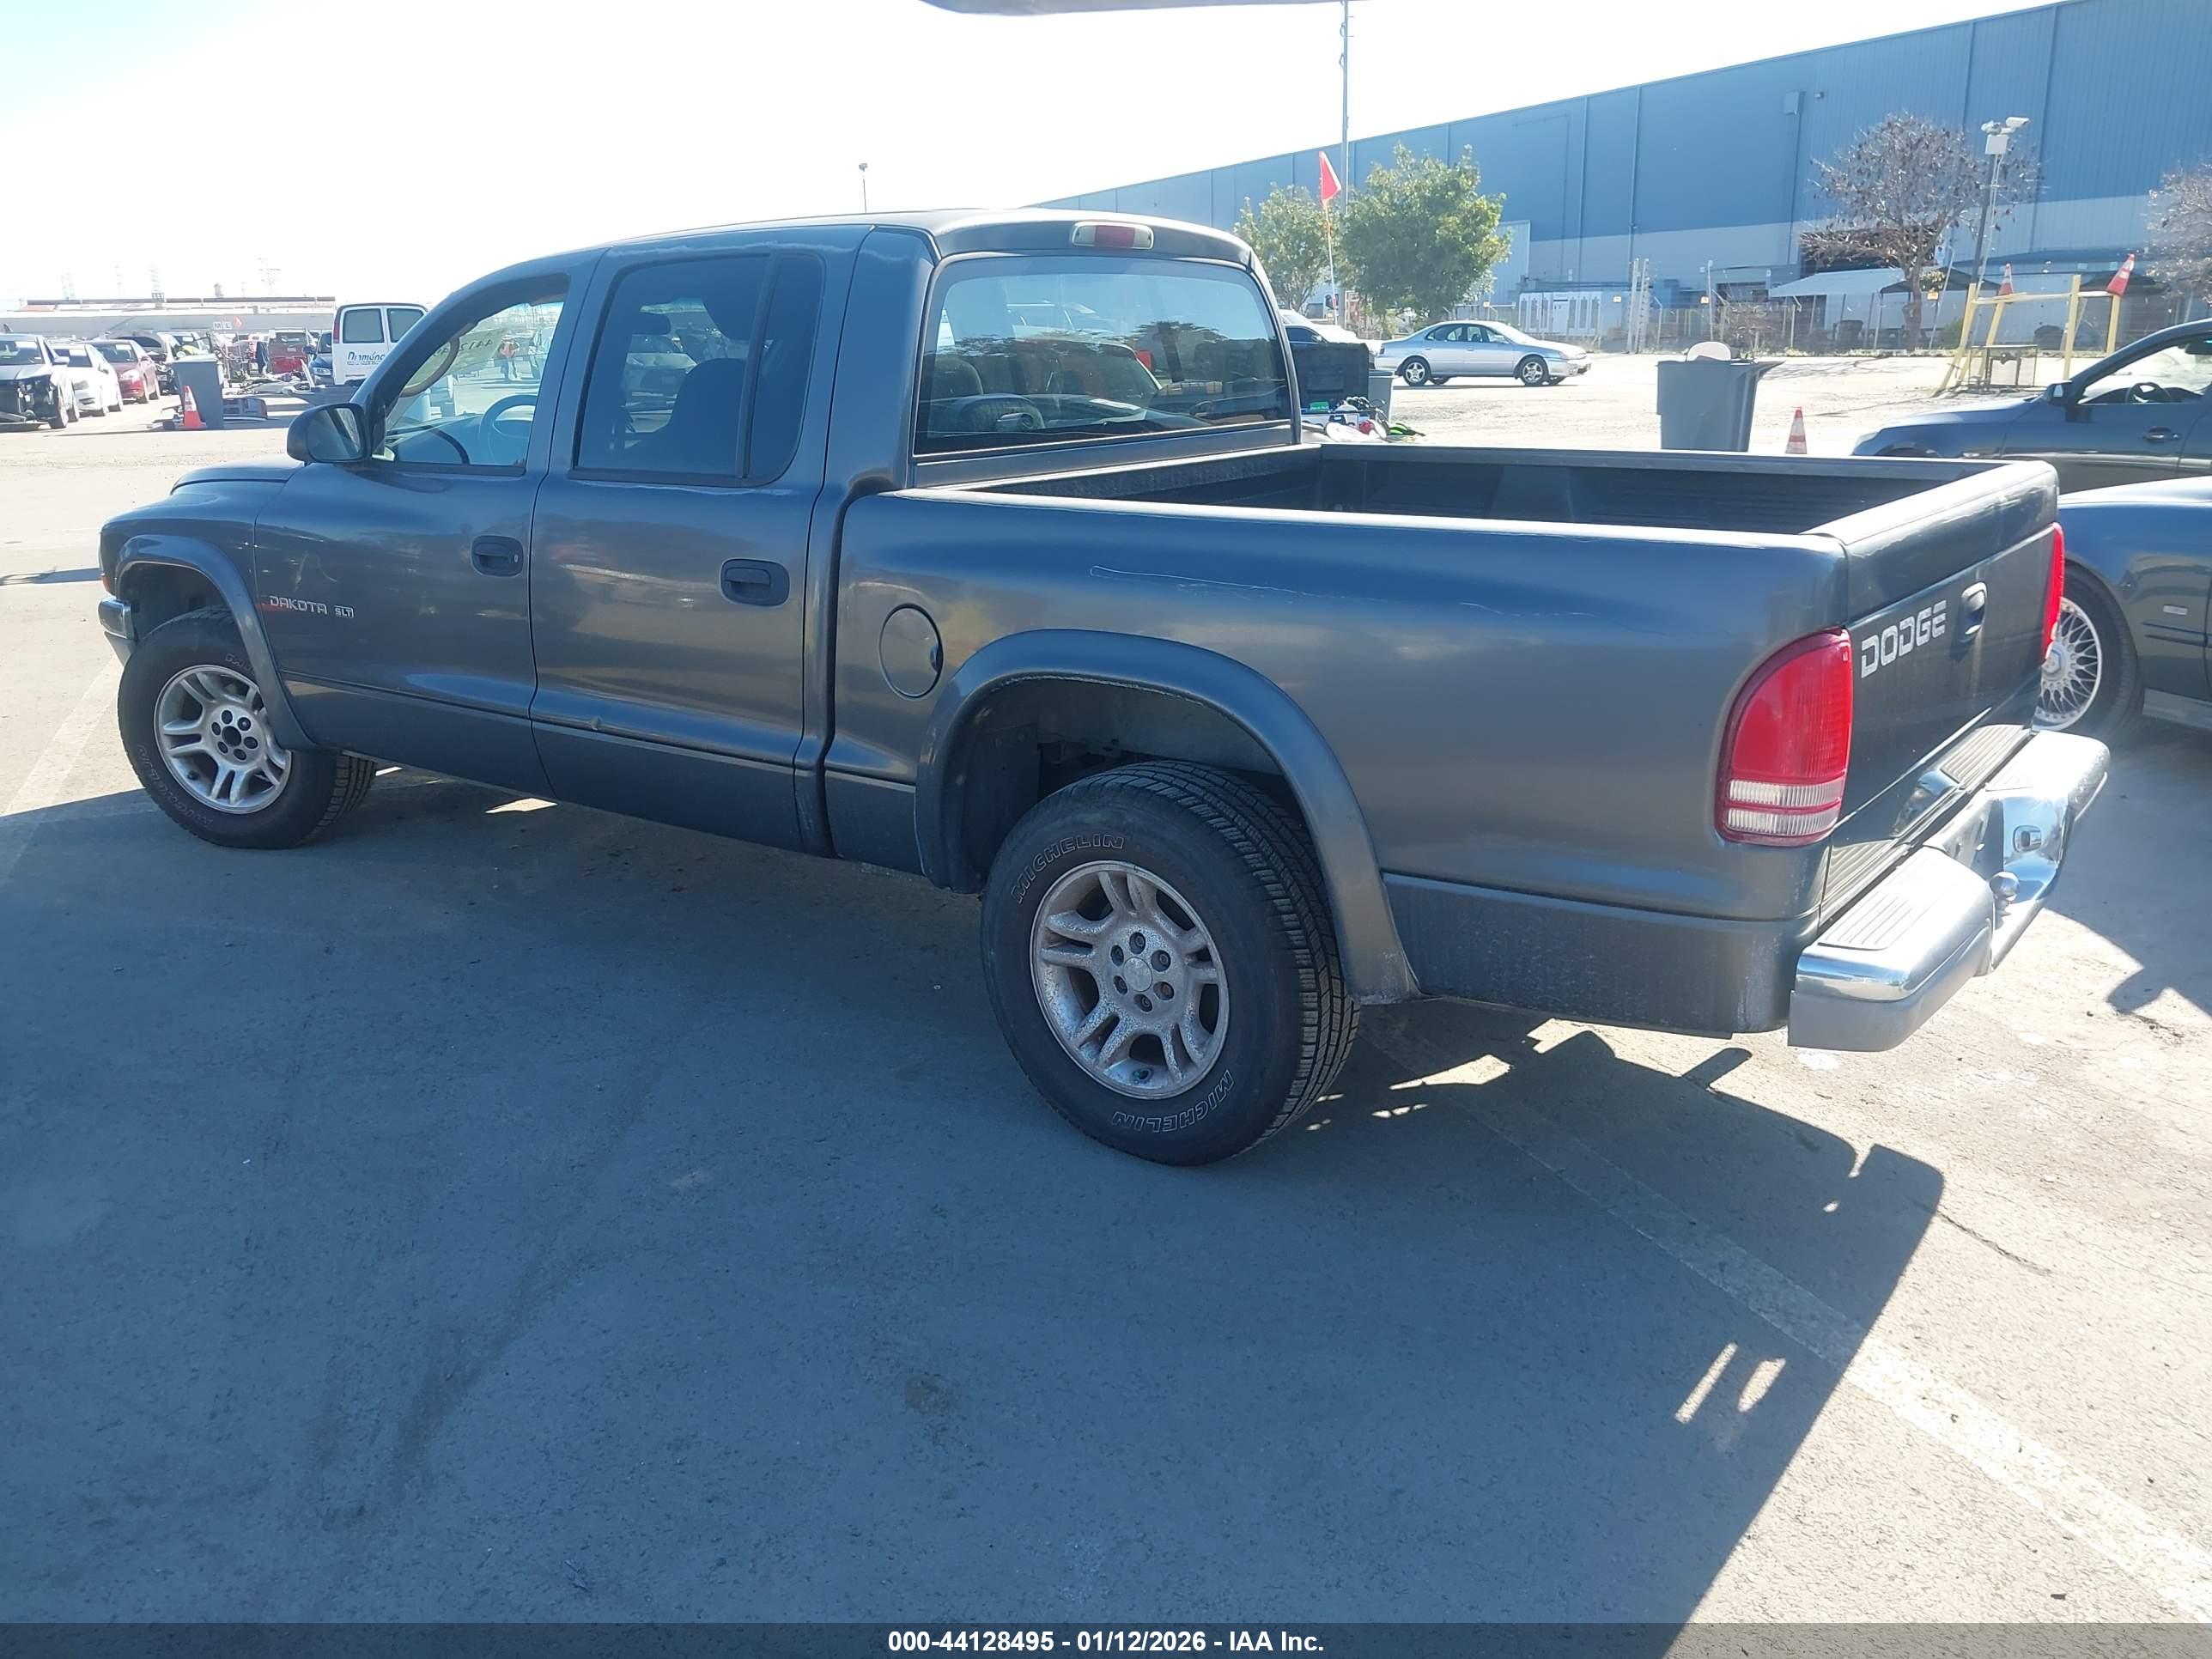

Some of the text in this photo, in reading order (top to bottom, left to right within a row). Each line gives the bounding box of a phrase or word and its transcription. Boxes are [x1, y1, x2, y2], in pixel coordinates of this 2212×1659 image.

[269, 595, 355, 618] DAKOTA SLT
[1861, 599, 1947, 678] DODGE
[1011, 833, 1124, 904] MICHELIN
[1112, 1069, 1235, 1133] MICHELIN
